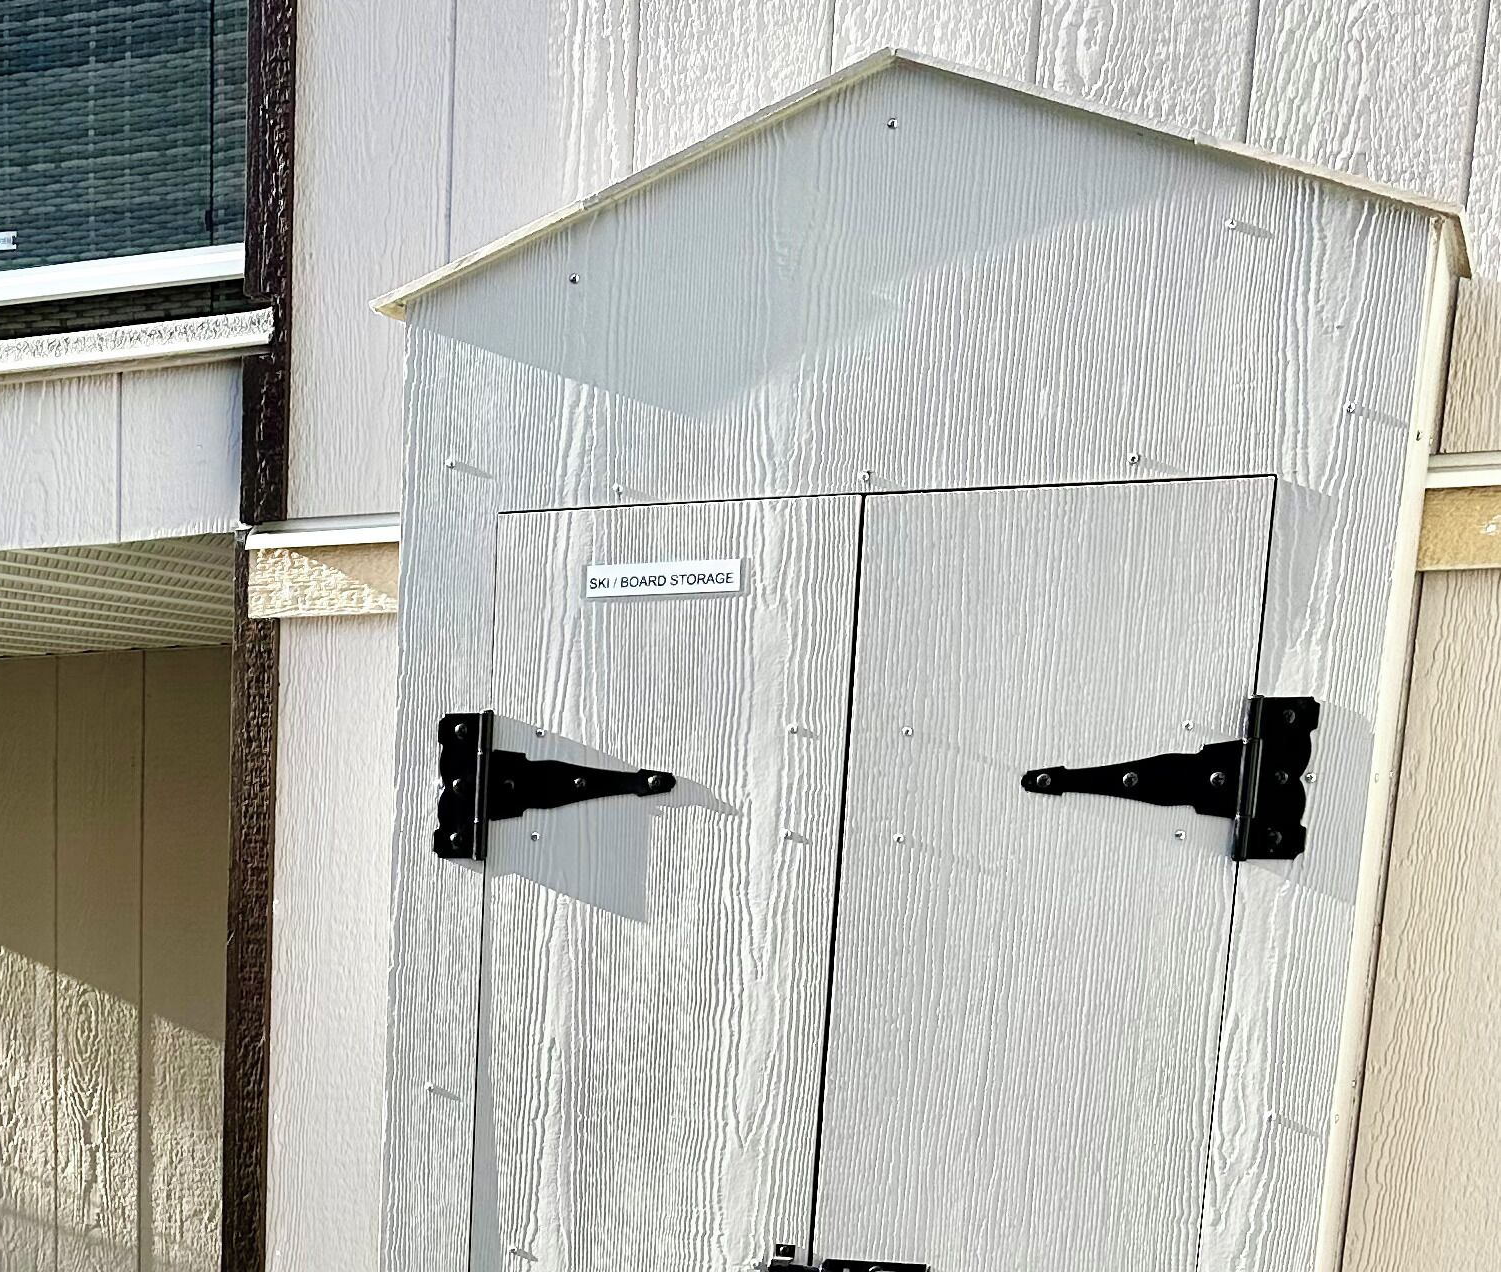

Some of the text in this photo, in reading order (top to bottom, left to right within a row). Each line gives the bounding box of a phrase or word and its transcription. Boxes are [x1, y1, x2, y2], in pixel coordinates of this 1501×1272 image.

[589, 577, 610, 590] SKI
[620, 575, 667, 588] BOARD
[670, 572, 734, 586] STORAGE
